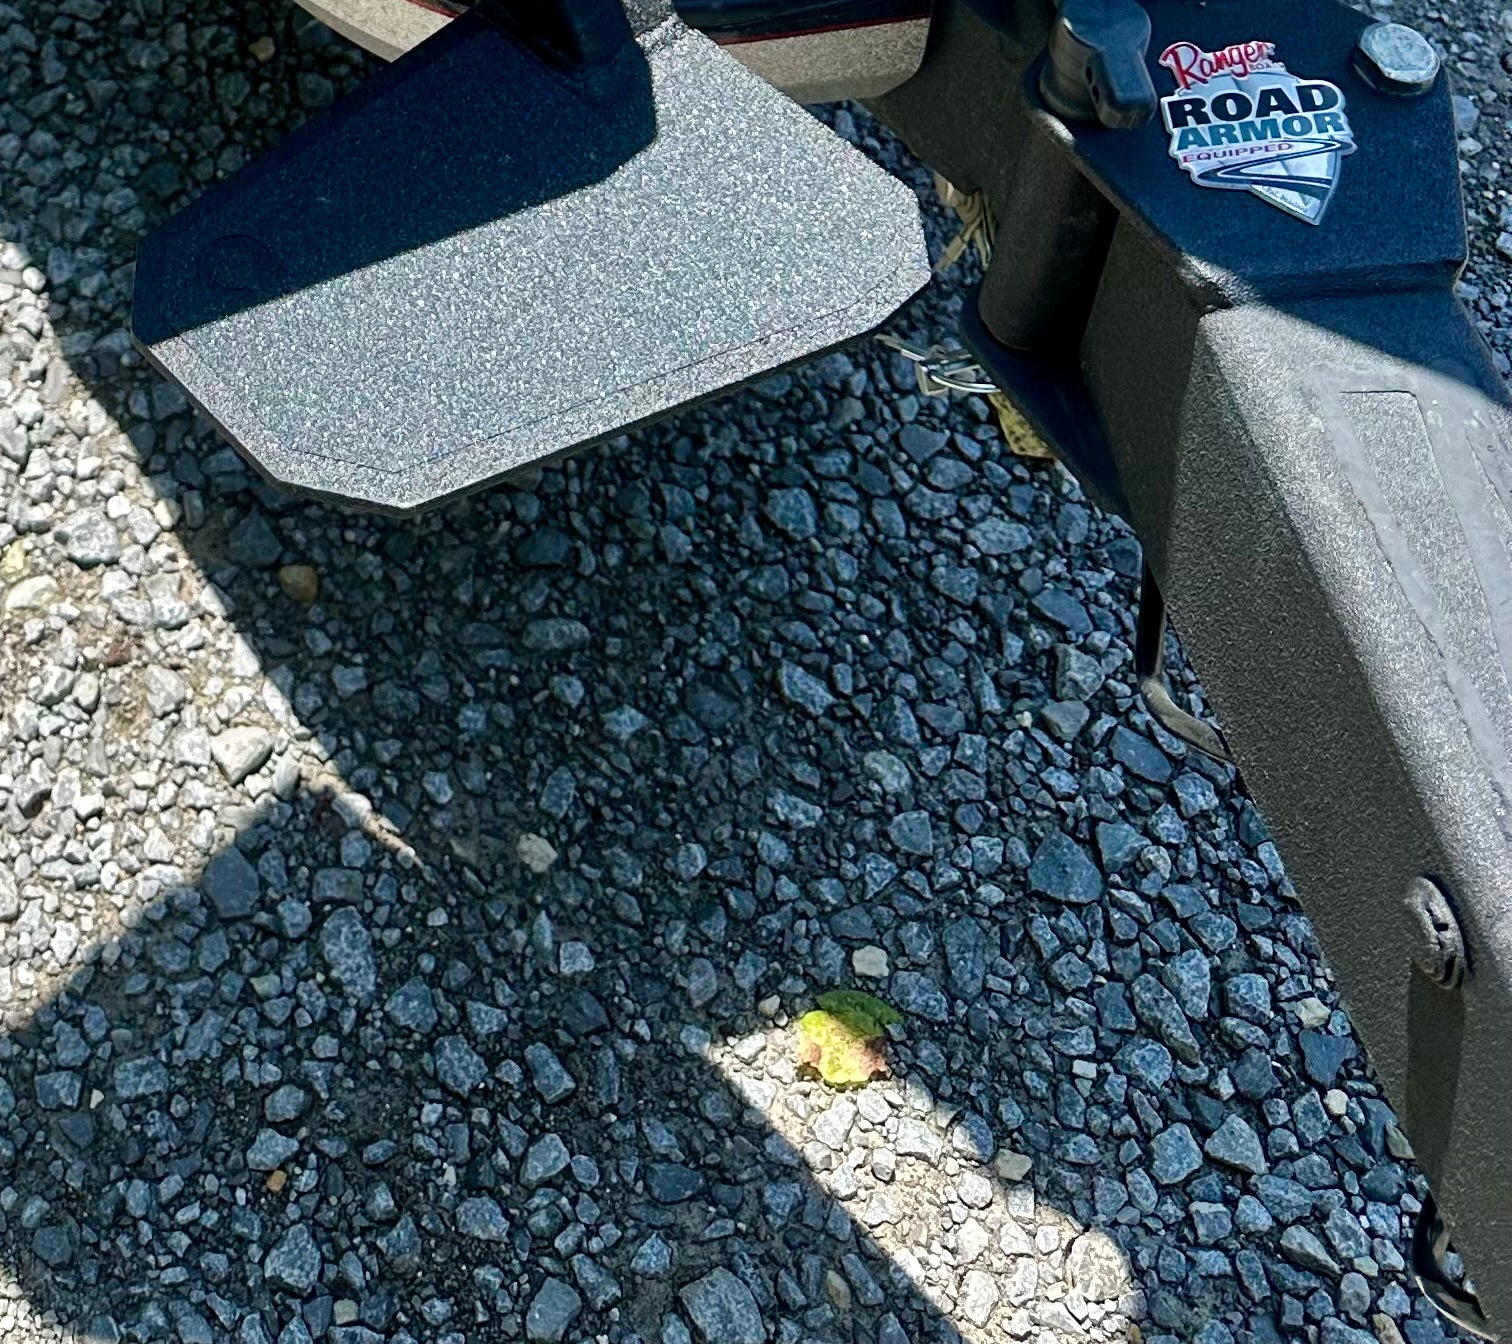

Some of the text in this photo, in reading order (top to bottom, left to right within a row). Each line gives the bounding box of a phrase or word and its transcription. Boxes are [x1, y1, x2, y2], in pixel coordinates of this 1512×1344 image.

[1160, 42, 1269, 90] Ranger
[1167, 84, 1340, 129] ROAD
[1177, 112, 1345, 151] ARMOR
[1182, 143, 1294, 163] EQUIPPED
